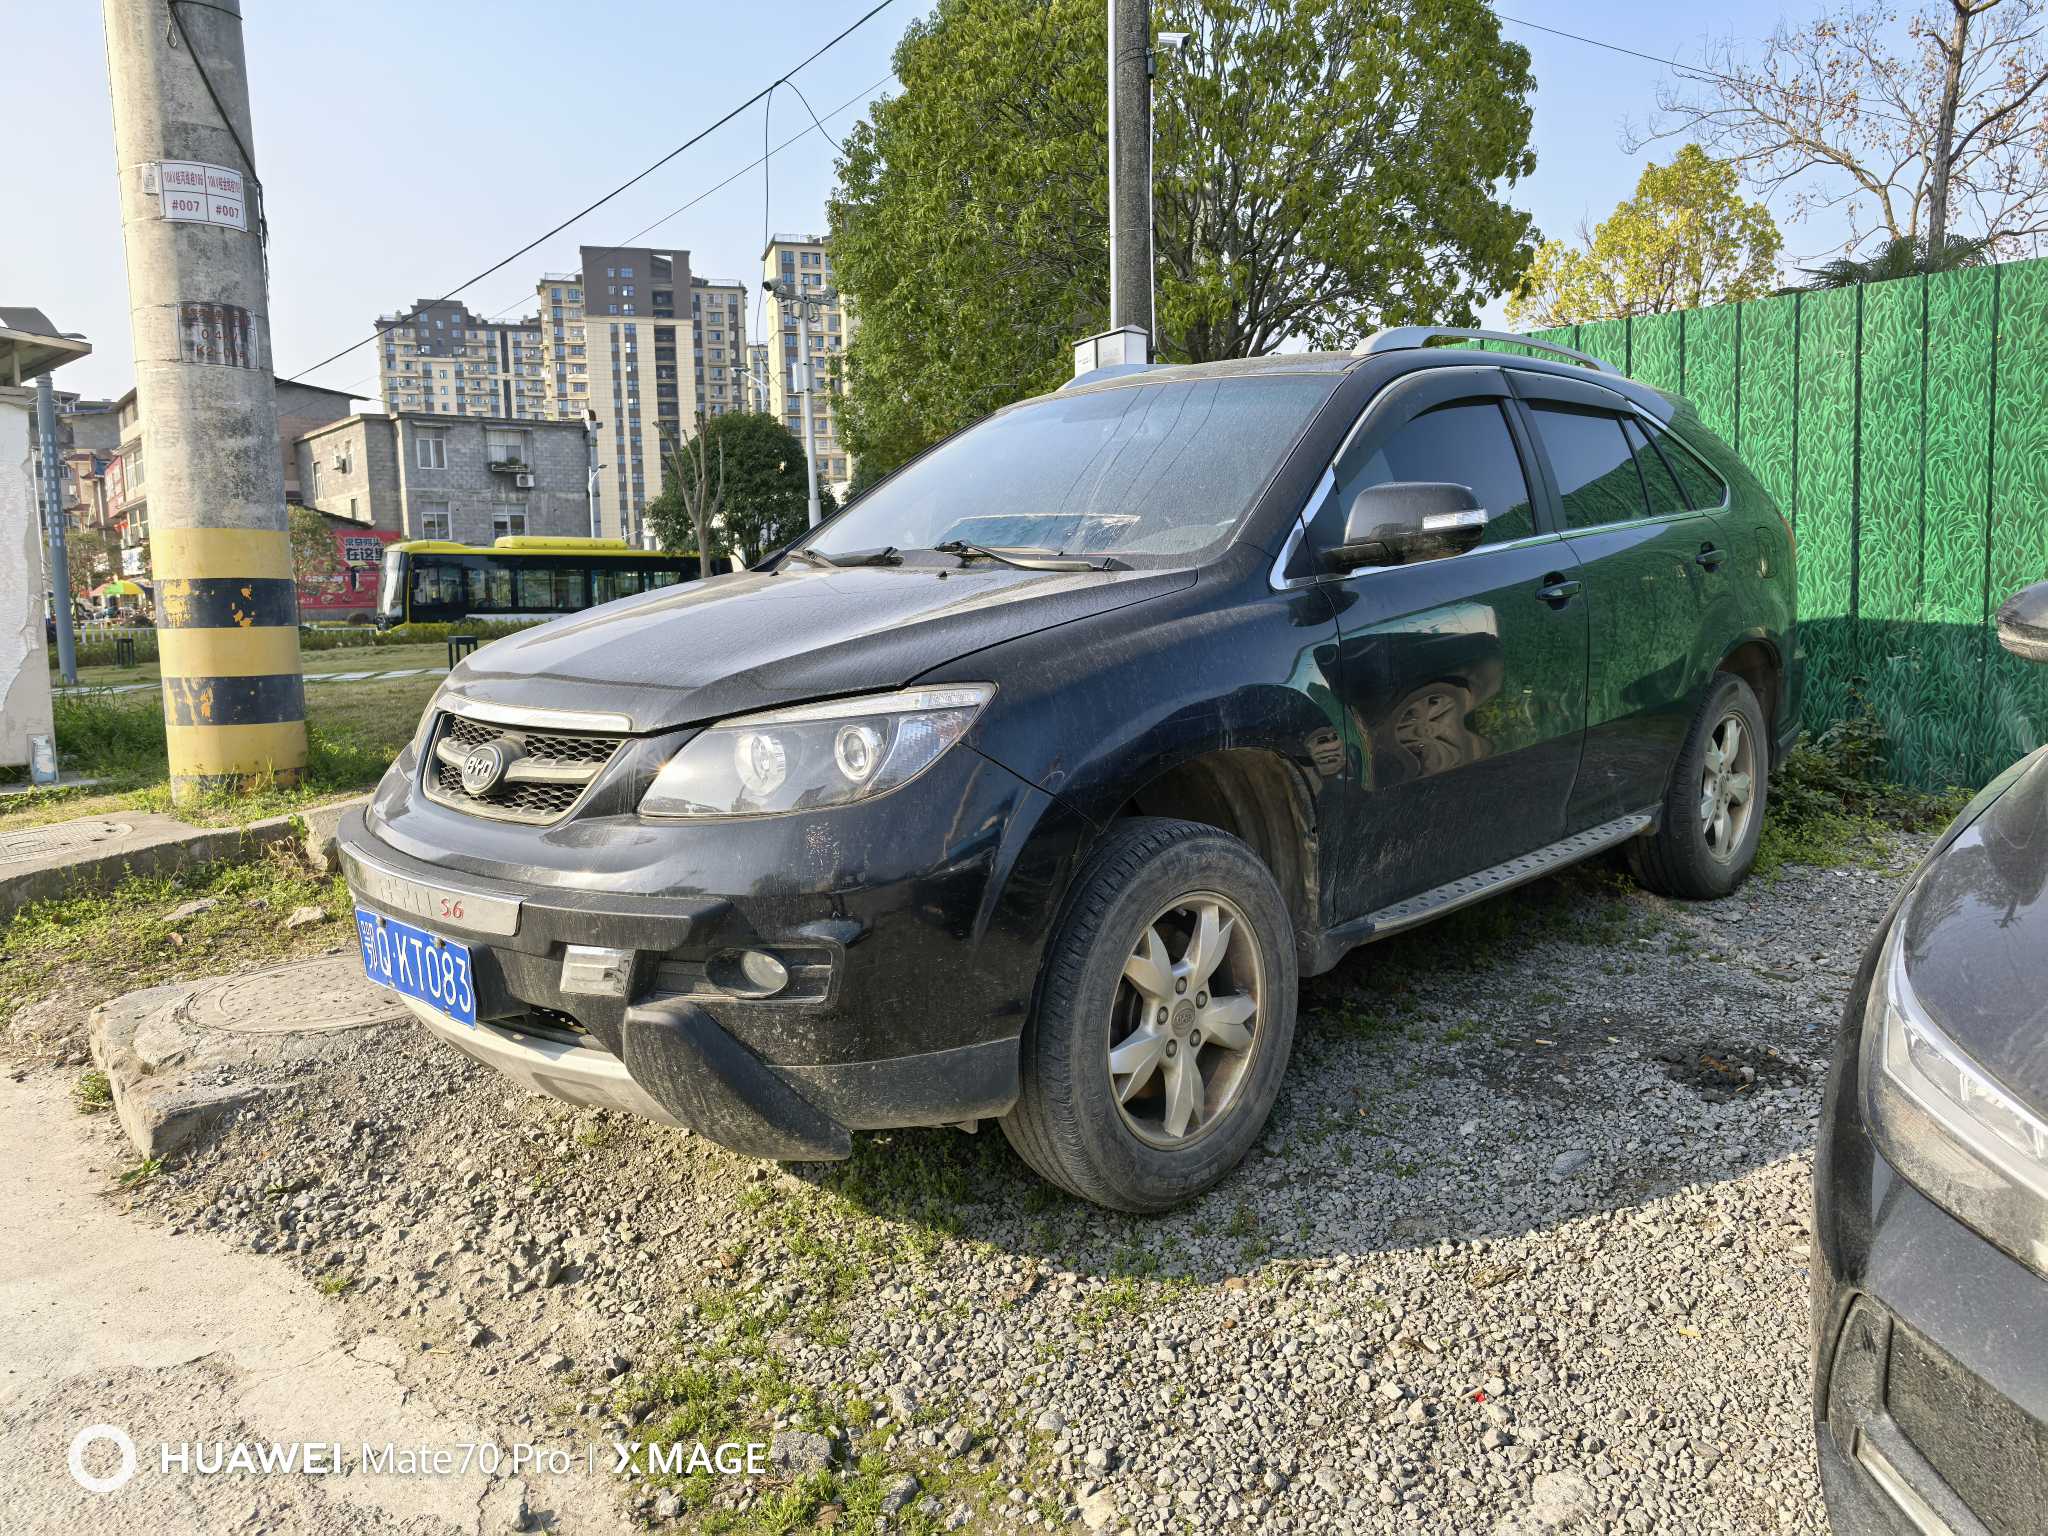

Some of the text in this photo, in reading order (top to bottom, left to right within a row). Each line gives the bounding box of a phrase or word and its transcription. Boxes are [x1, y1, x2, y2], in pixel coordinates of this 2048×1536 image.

[172, 199, 200, 213] #007
[215, 204, 240, 219] #007
[465, 756, 495, 779] BYD
[440, 897, 464, 920] S6
